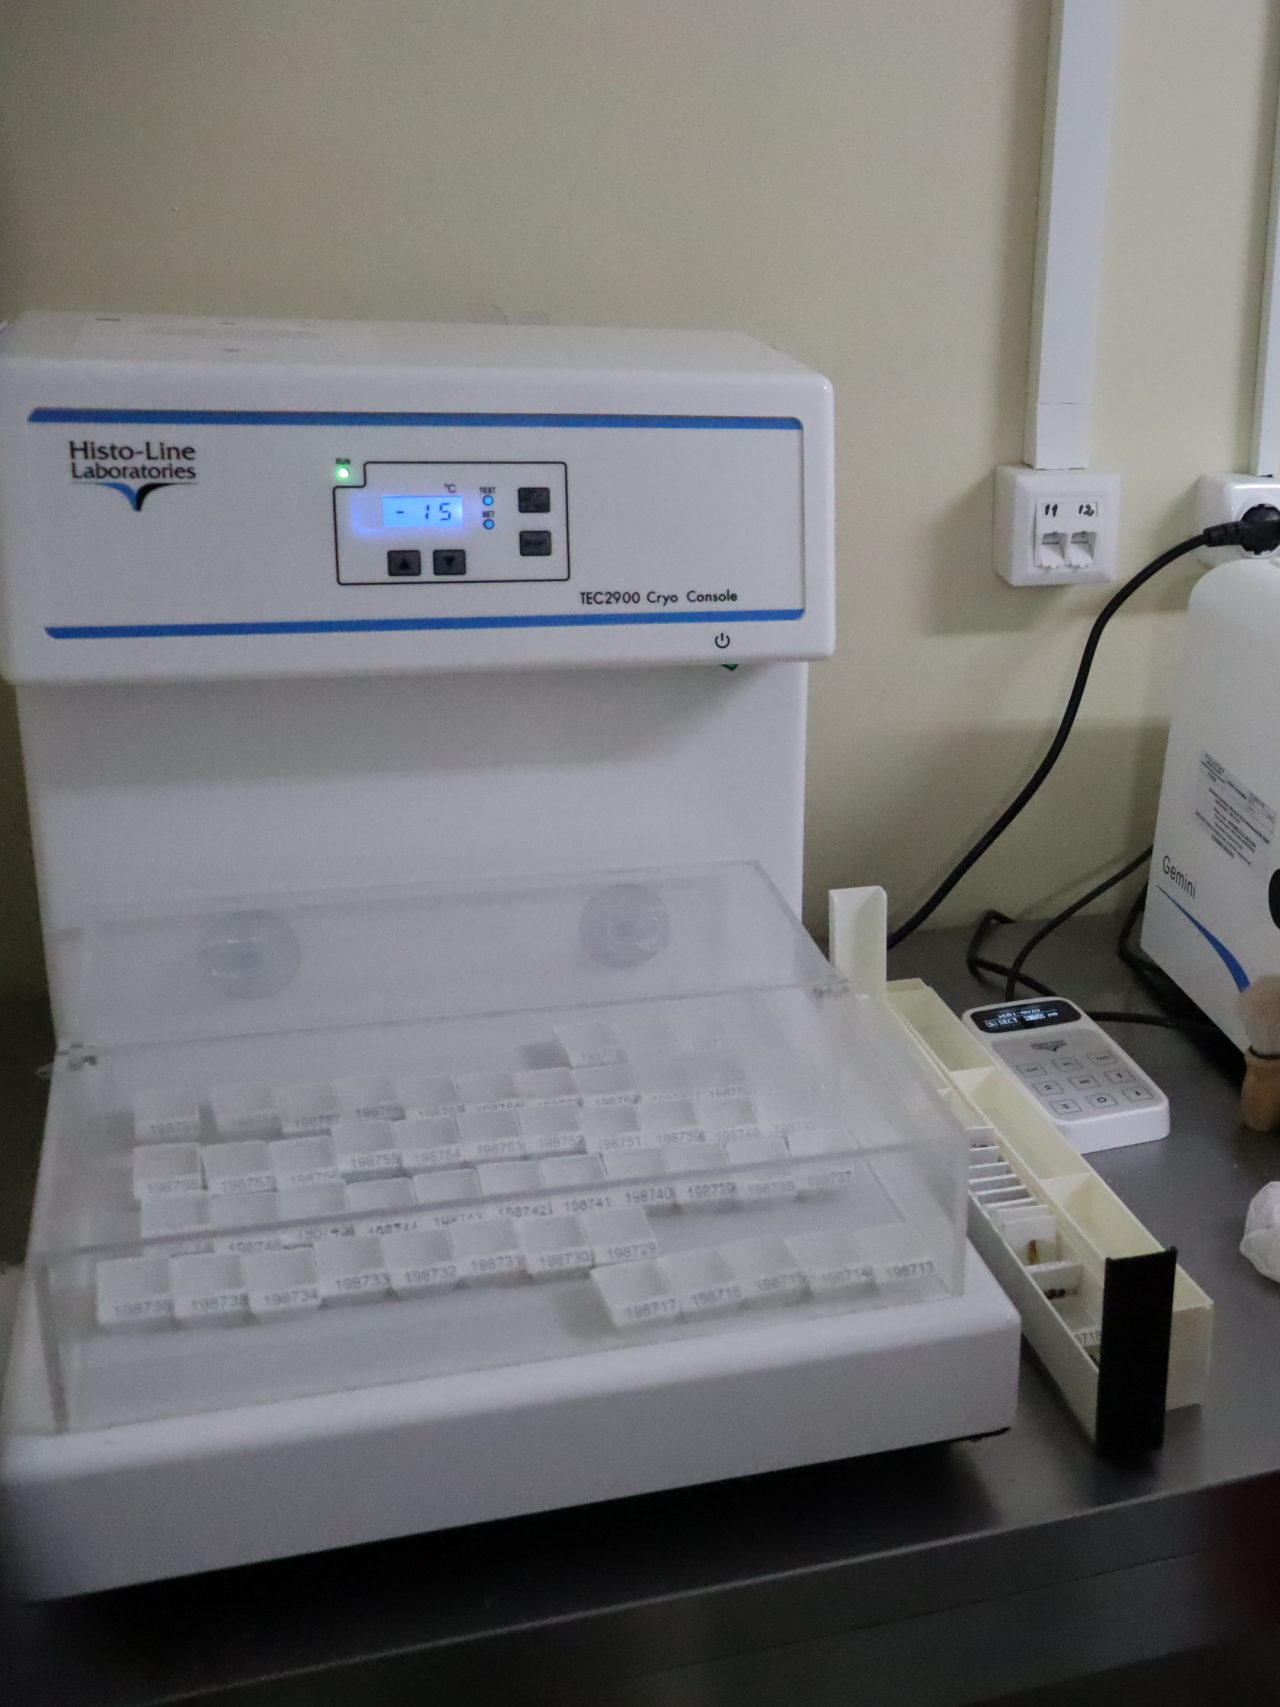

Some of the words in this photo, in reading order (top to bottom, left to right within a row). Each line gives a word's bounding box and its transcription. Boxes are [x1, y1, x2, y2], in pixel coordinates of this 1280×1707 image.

[69, 440, 196, 460] Histo-Line
[71, 462, 197, 479] Laboratories
[479, 486, 496, 494] TEST
[1078, 503, 1095, 517] 12
[580, 591, 641, 605] TEC2900
[646, 590, 679, 606] Cryo
[686, 589, 738, 604] Console
[1162, 855, 1198, 900] Gemini
[540, 1250, 591, 1268] 198730
[608, 1241, 657, 1260] 198729
[405, 1265, 457, 1284] 198732
[886, 1259, 935, 1279] 198713
[336, 1271, 390, 1291] 198733
[626, 1298, 676, 1318] 198717
